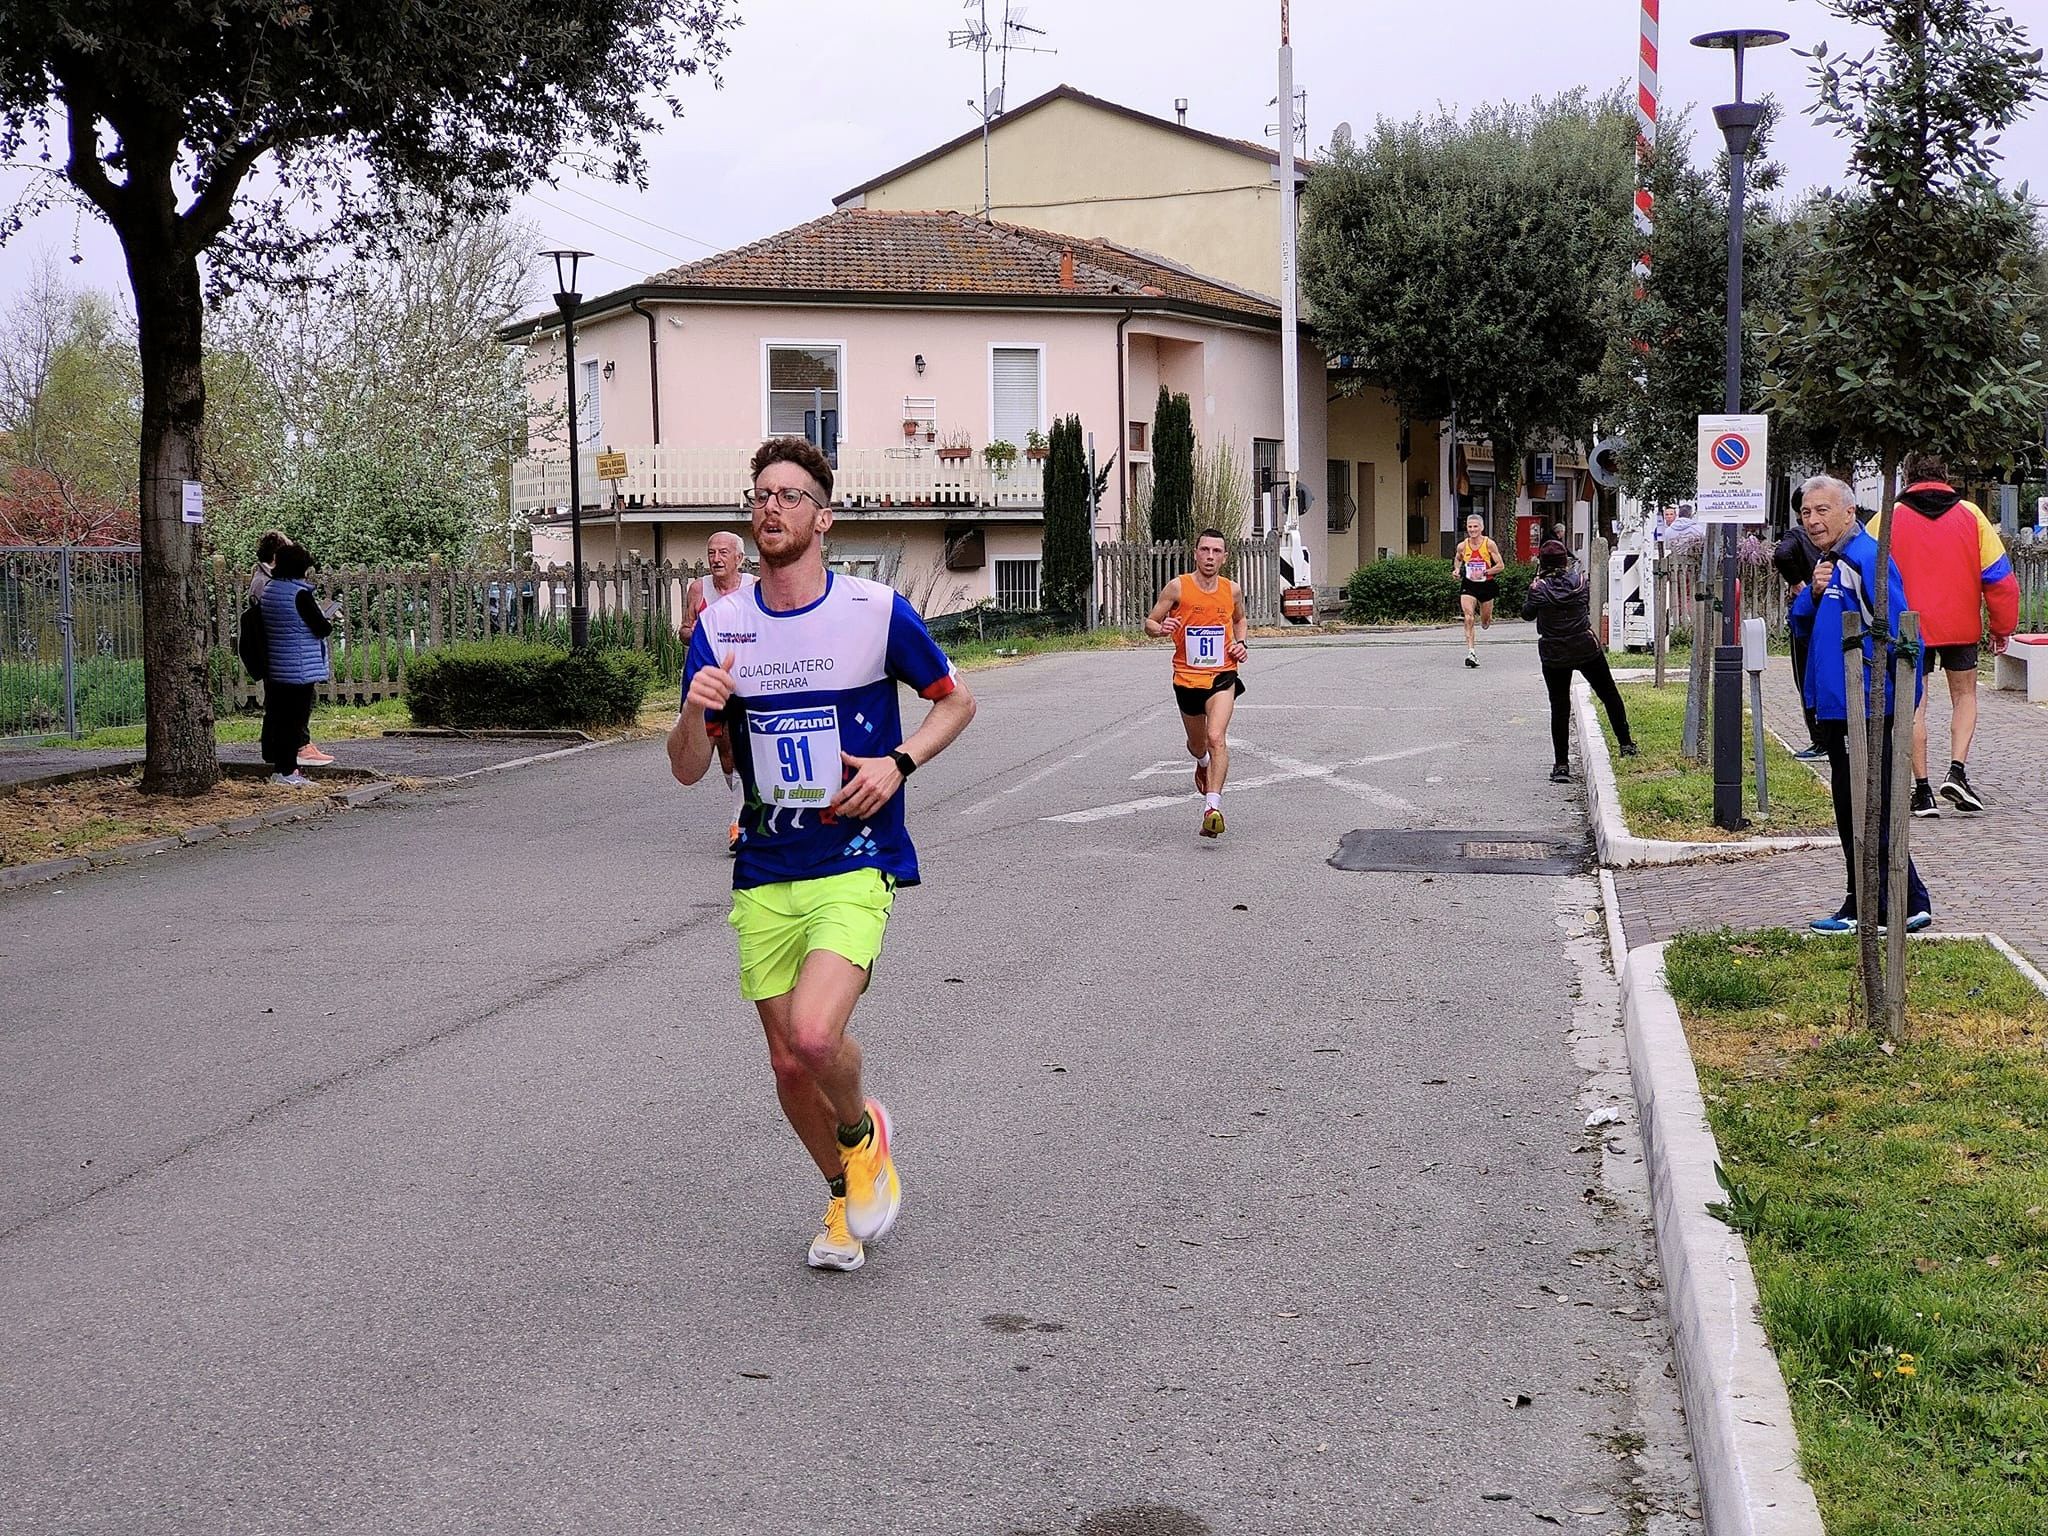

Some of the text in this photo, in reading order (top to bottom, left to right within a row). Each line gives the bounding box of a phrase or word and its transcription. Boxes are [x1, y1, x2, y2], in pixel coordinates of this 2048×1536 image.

[1200, 637, 1214, 656] 61
[739, 658, 834, 678] QUADRILATERO
[760, 678, 809, 691] FERRARA
[776, 736, 813, 783] 91
